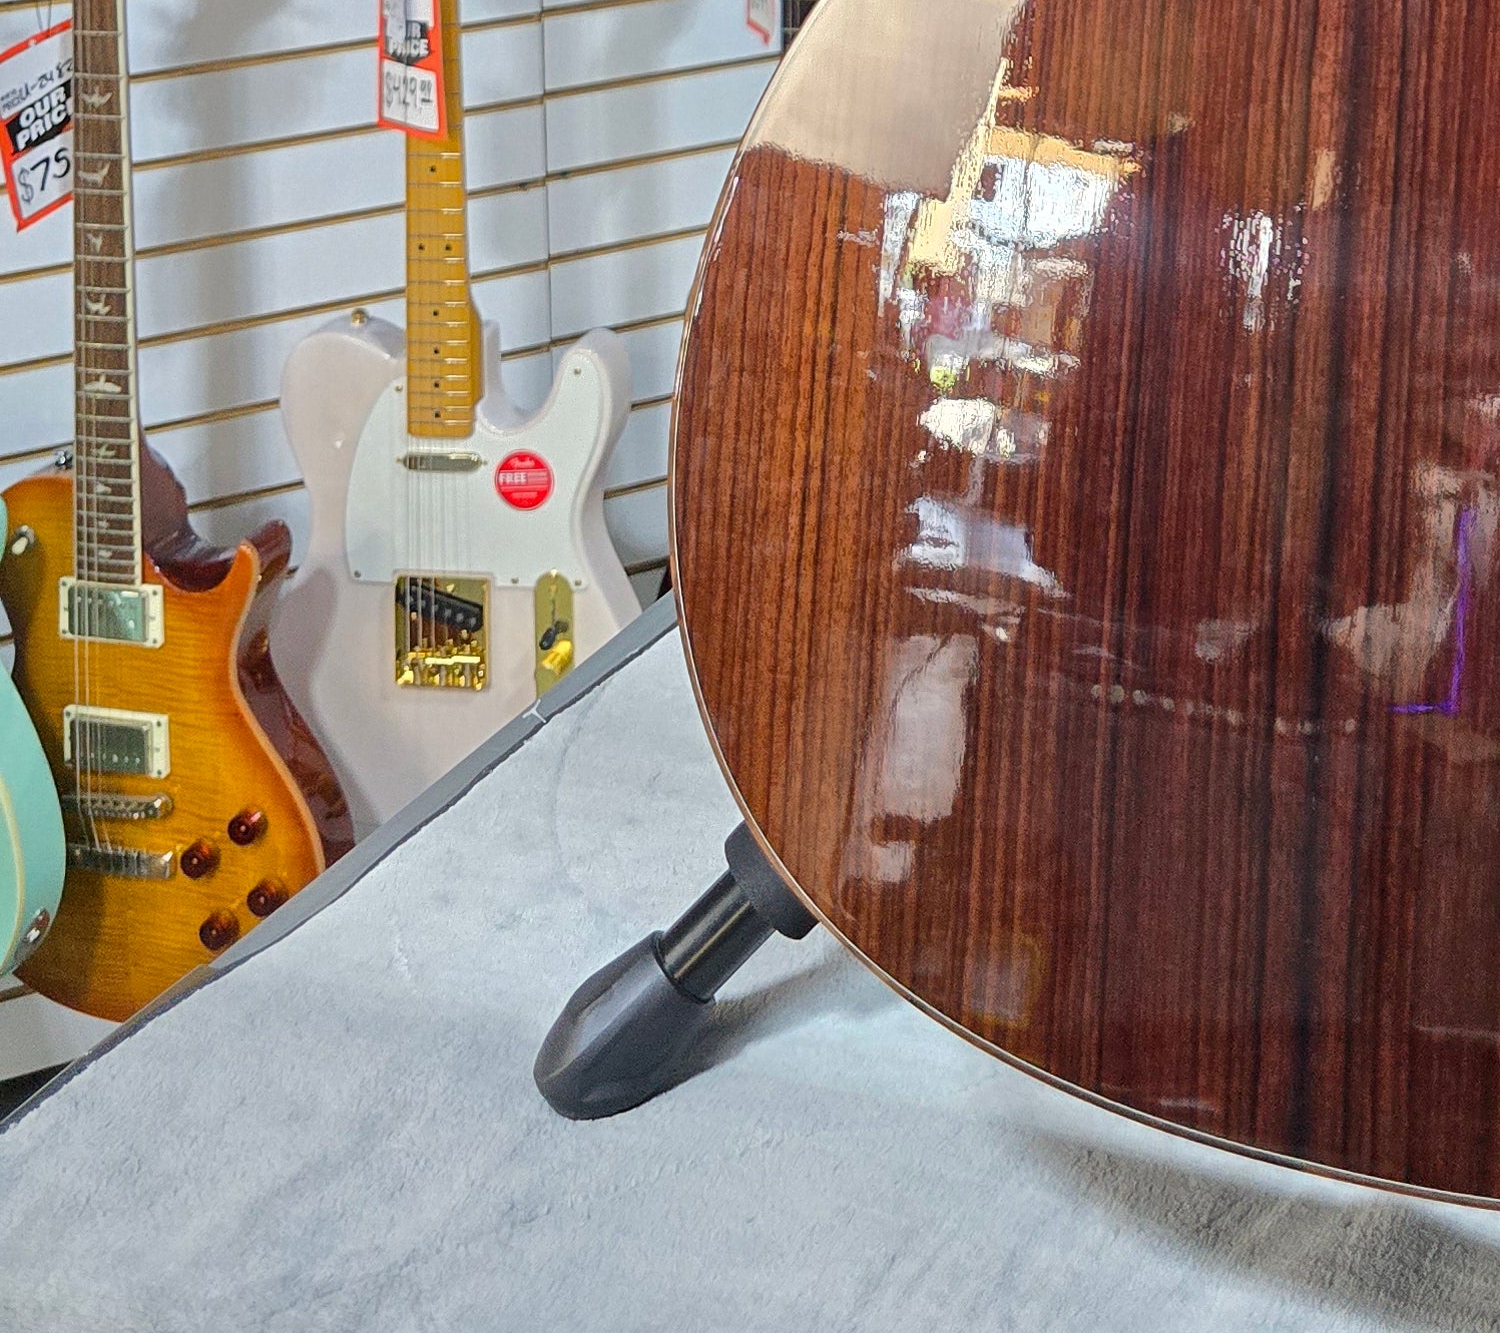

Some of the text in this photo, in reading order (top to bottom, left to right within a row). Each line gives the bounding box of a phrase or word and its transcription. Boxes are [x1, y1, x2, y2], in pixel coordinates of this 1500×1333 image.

[388, 37, 430, 58] PRICE
[19, 85, 67, 129] OUR
[499, 472, 527, 486] FREE
